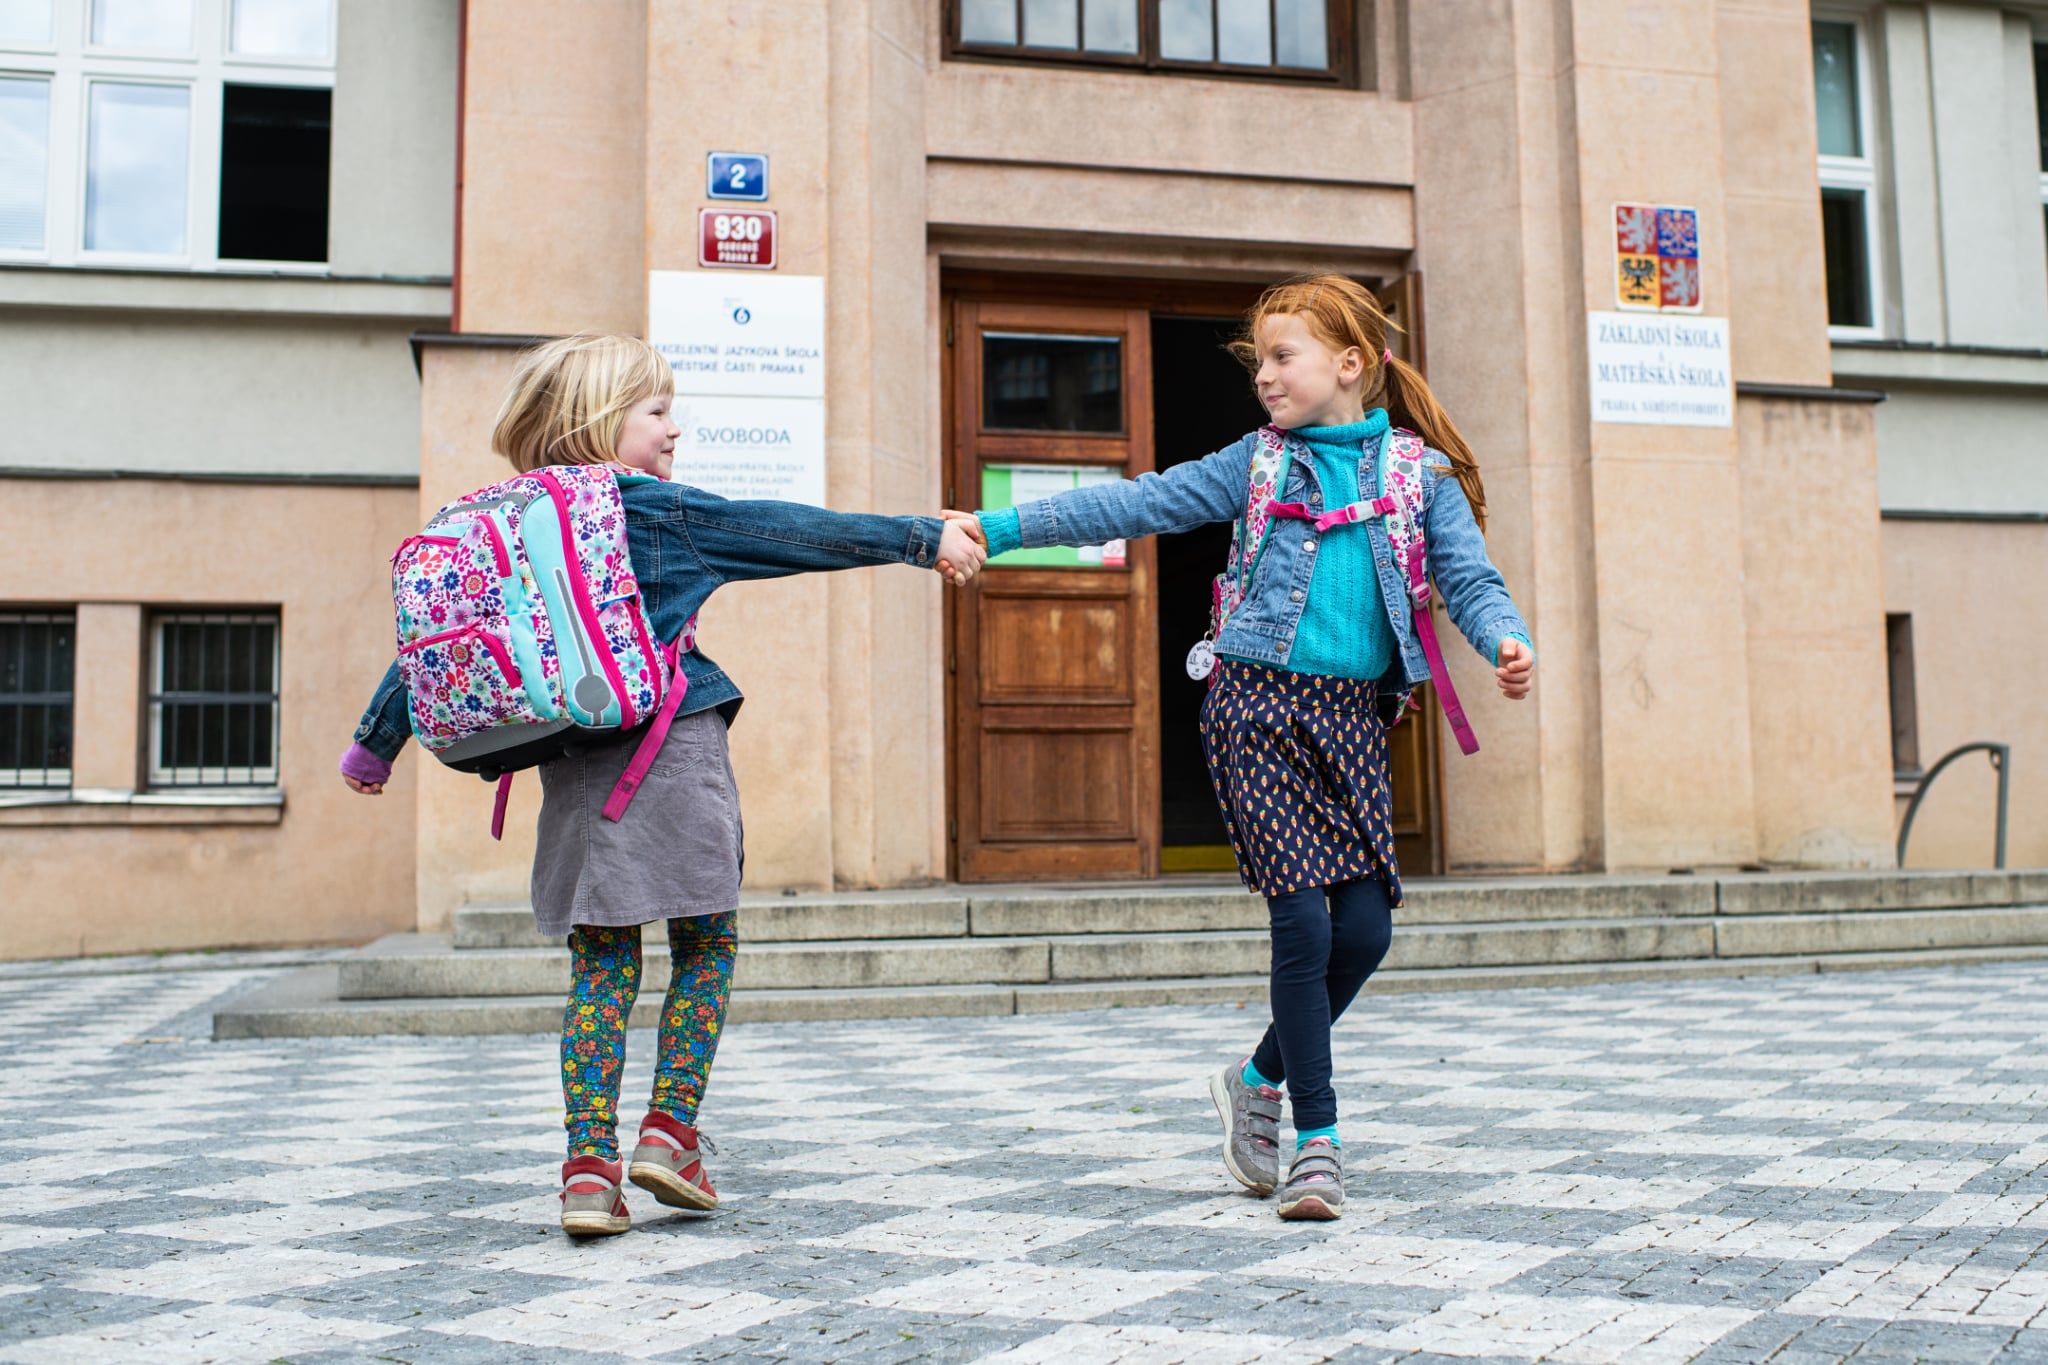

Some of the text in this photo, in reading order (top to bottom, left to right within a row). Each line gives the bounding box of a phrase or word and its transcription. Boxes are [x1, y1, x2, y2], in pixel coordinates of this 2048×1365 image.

[730, 163, 746, 189] 2
[714, 215, 762, 241] 930
[1599, 321, 1722, 349] ZÁKLADNÍ ŠKOLA
[724, 344, 779, 356] JAZYKOVÁ
[784, 344, 820, 358] ŠKOLA
[760, 363, 797, 374] PRAHA
[1598, 360, 1726, 388] MATEŘSKÁ ŠKOLA
[697, 427, 791, 444] SVOBODA
